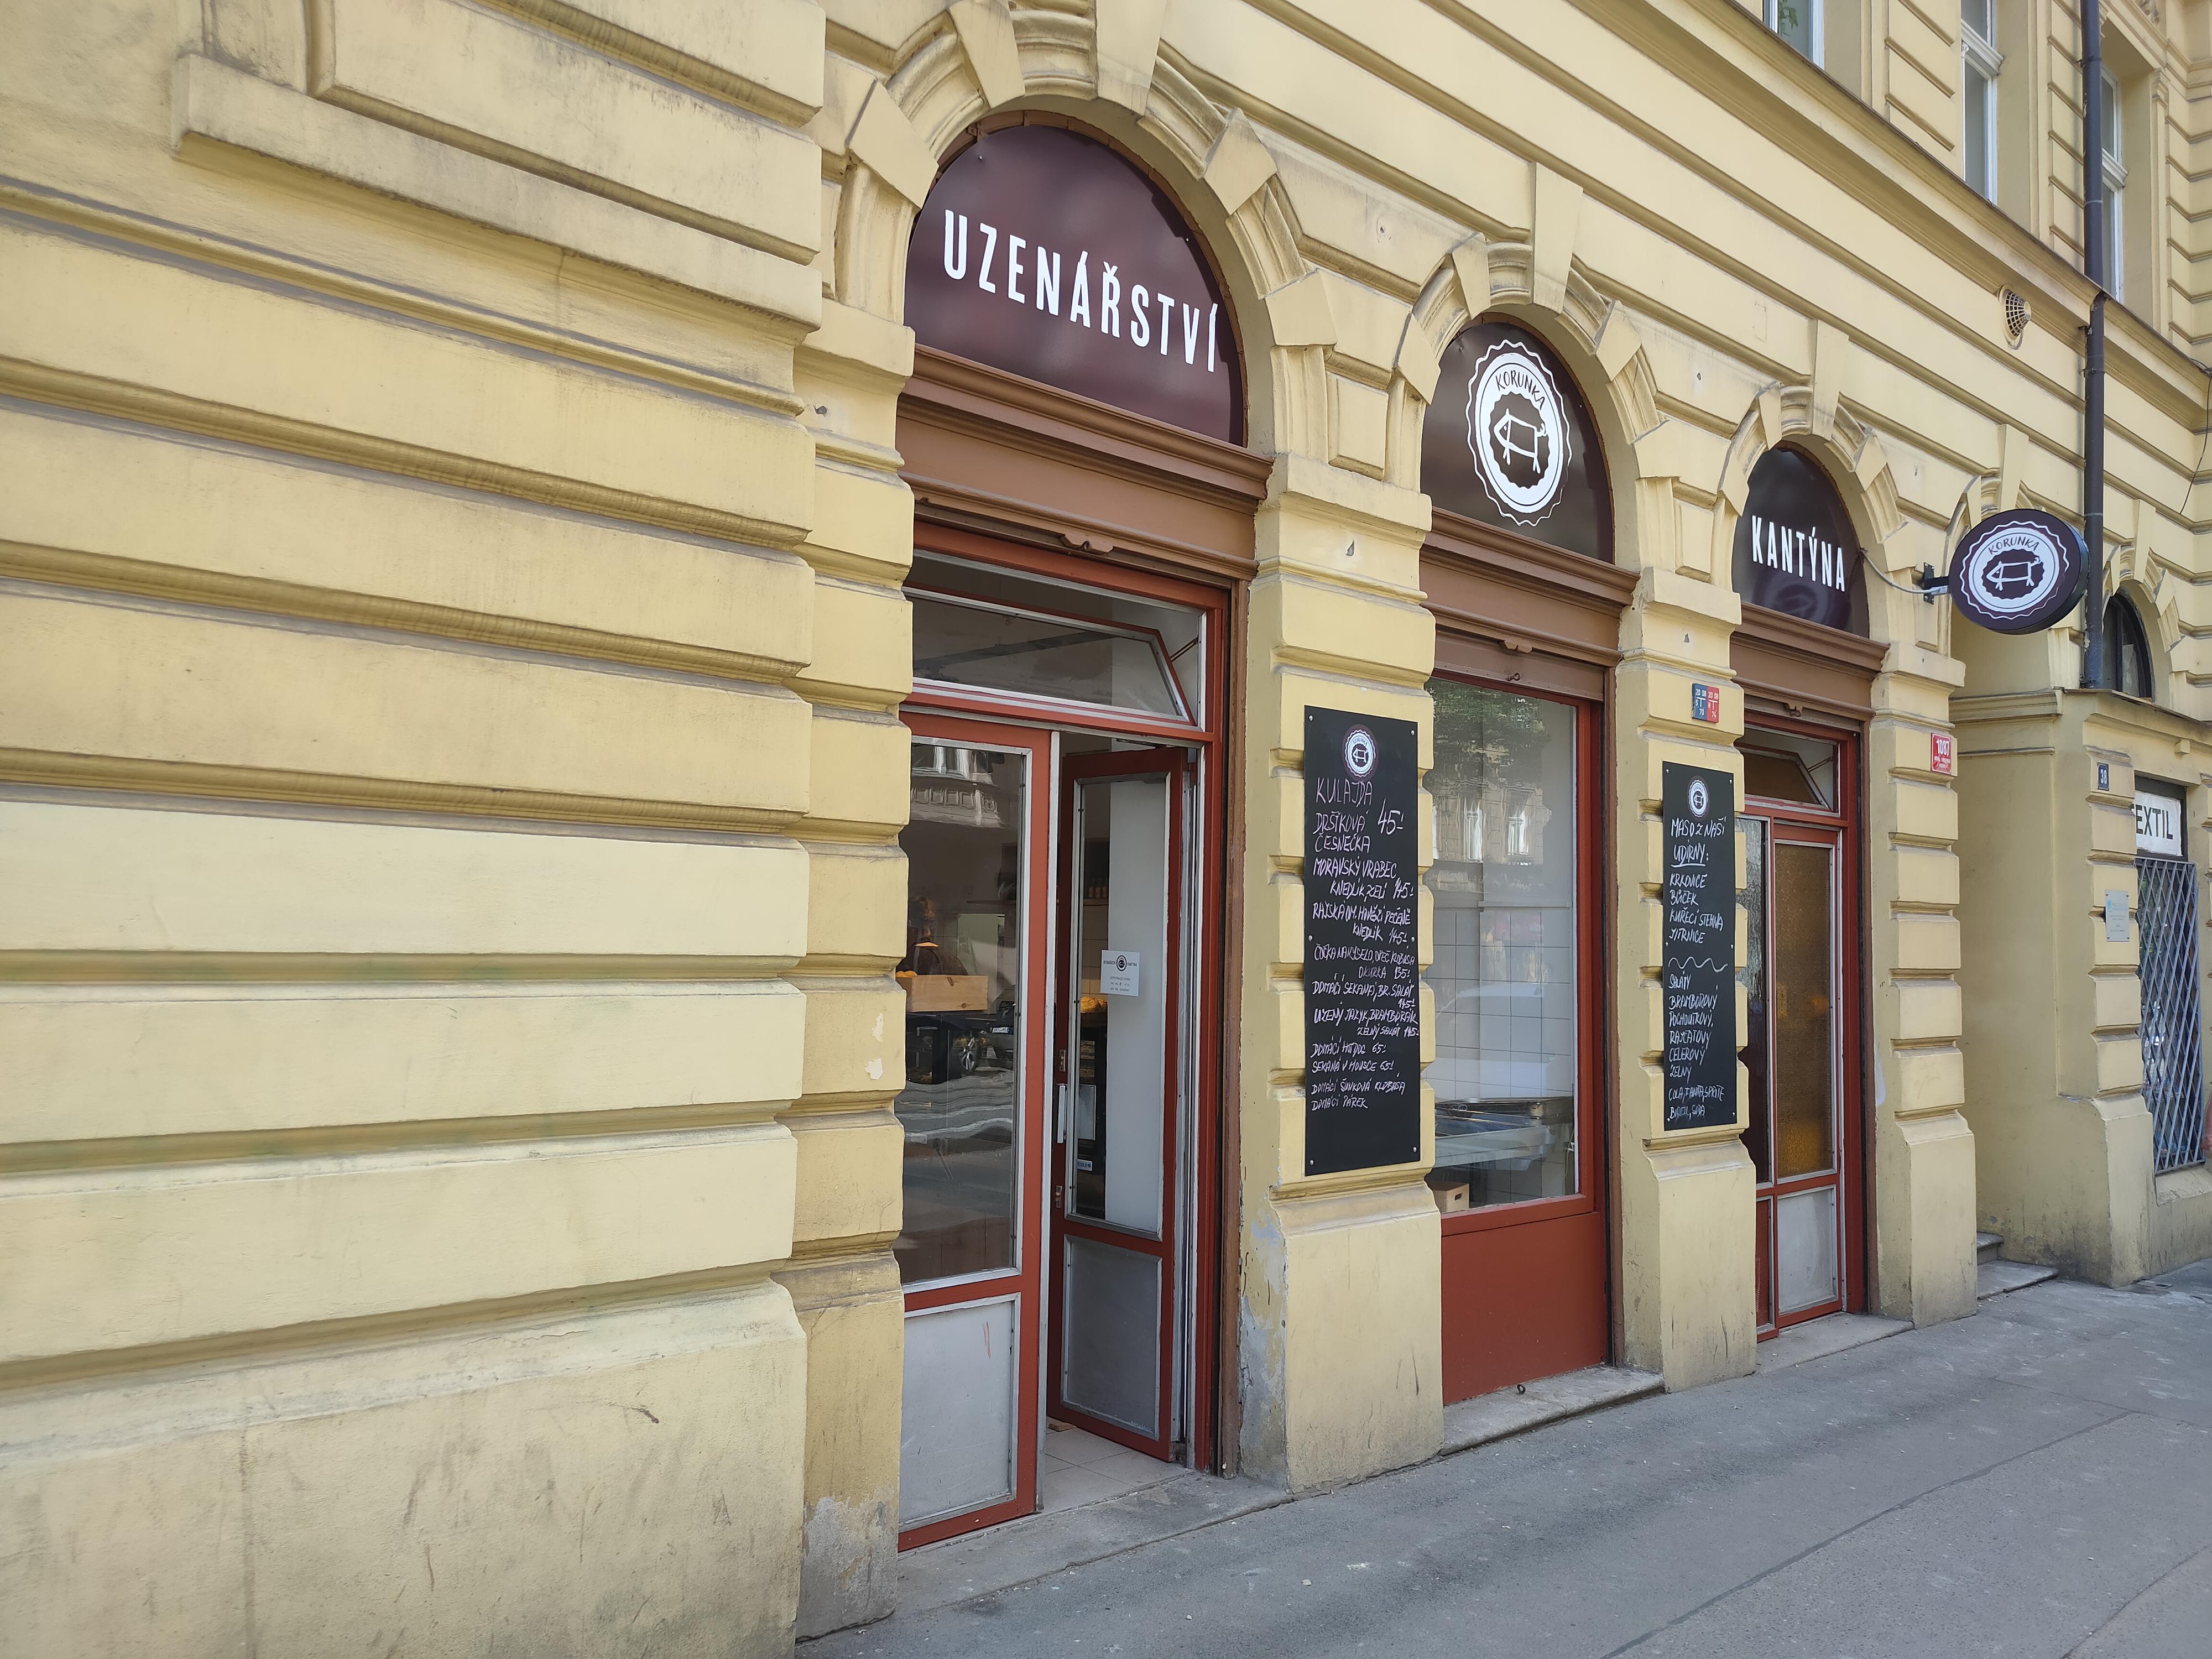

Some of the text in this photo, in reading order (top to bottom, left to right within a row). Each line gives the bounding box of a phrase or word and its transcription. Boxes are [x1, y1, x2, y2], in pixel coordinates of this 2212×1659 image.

[943, 209, 1218, 373] UZENÁŘSTVÍ
[1495, 369, 1545, 410] KORUNKA
[1751, 515, 1845, 592] KANTÝNA
[1987, 536, 2040, 555] KORUNKA
[1936, 738, 1949, 756] 1087
[2100, 769, 2107, 784] 38
[1316, 777, 1373, 808] KULAJDA
[1671, 817, 1695, 838] MASO
[1703, 816, 1727, 838] NAŠÍ
[2131, 804, 2173, 840] EXTIL
[1312, 855, 1397, 879] MORAVSKÝ VRABEC
[1669, 873, 1708, 889] KRKOVICE
[1669, 907, 1724, 932] KUŘECÍ STEHNA
[1668, 927, 1706, 944] JITRNICE
[1358, 966, 1387, 979] OKURKA
[1668, 970, 1692, 990] SALÁTY
[1668, 984, 1719, 1010] BRAMBOROVÝ
[1311, 1056, 1342, 1073] SEKANÁ
[1342, 1059, 1348, 1071] V
[1668, 1046, 1706, 1066] CELEROVÝ
[1669, 1062, 1693, 1084] ZELNÝ
[1311, 1093, 1369, 1112] DOMÁCÍ PÁREK
